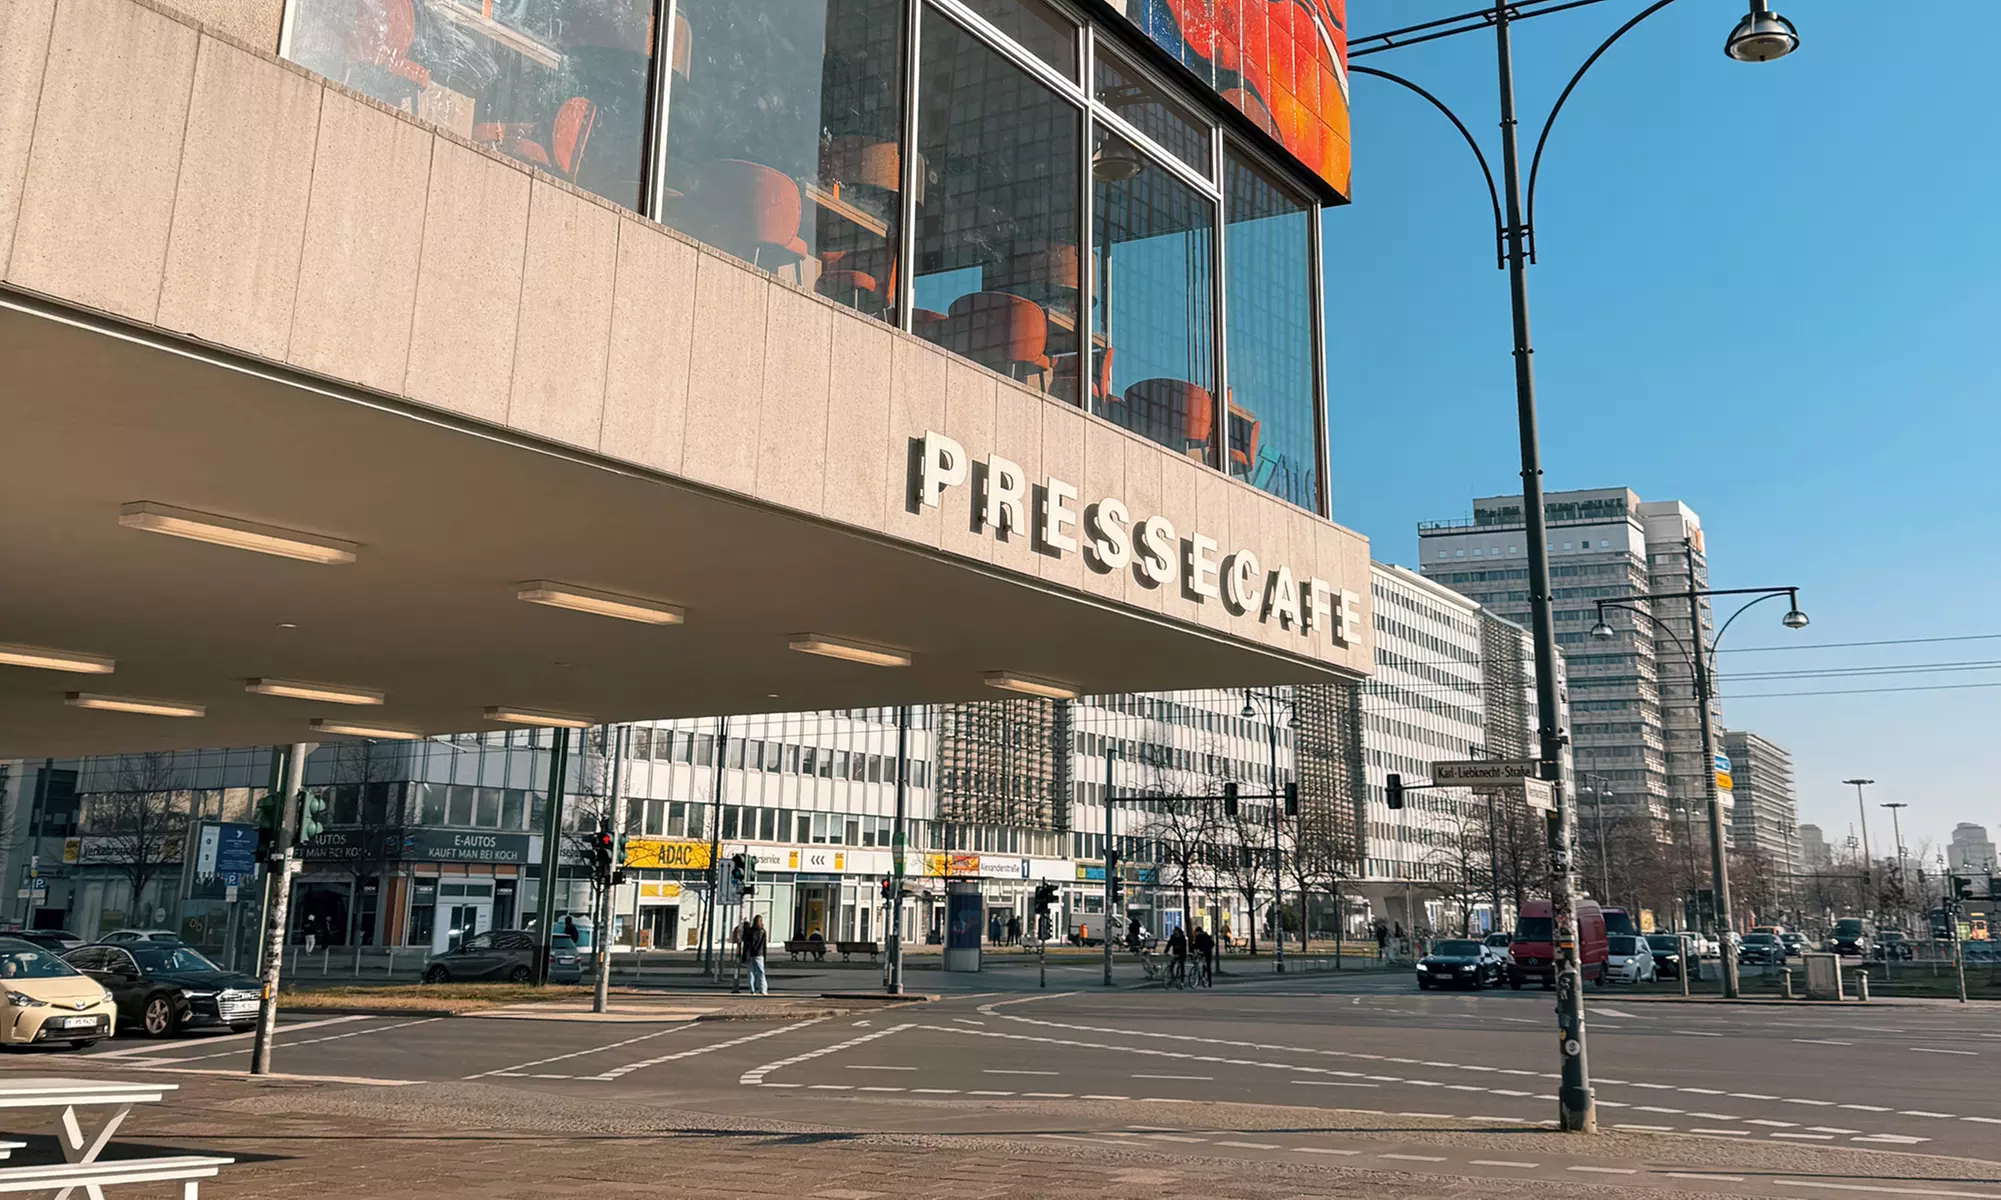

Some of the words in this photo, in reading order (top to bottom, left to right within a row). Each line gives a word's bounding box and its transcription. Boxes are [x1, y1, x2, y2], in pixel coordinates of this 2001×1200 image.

[921, 429, 1363, 647] PRESSECAFE
[1437, 765, 1532, 779] Karl-Liebknecht-Straße
[454, 834, 497, 848] E-AUTOS
[428, 847, 457, 859] KAUFT
[458, 848, 479, 860] MAN
[479, 849, 494, 860] BEI
[494, 850, 519, 861] KOCH
[657, 844, 694, 866] ADAC
